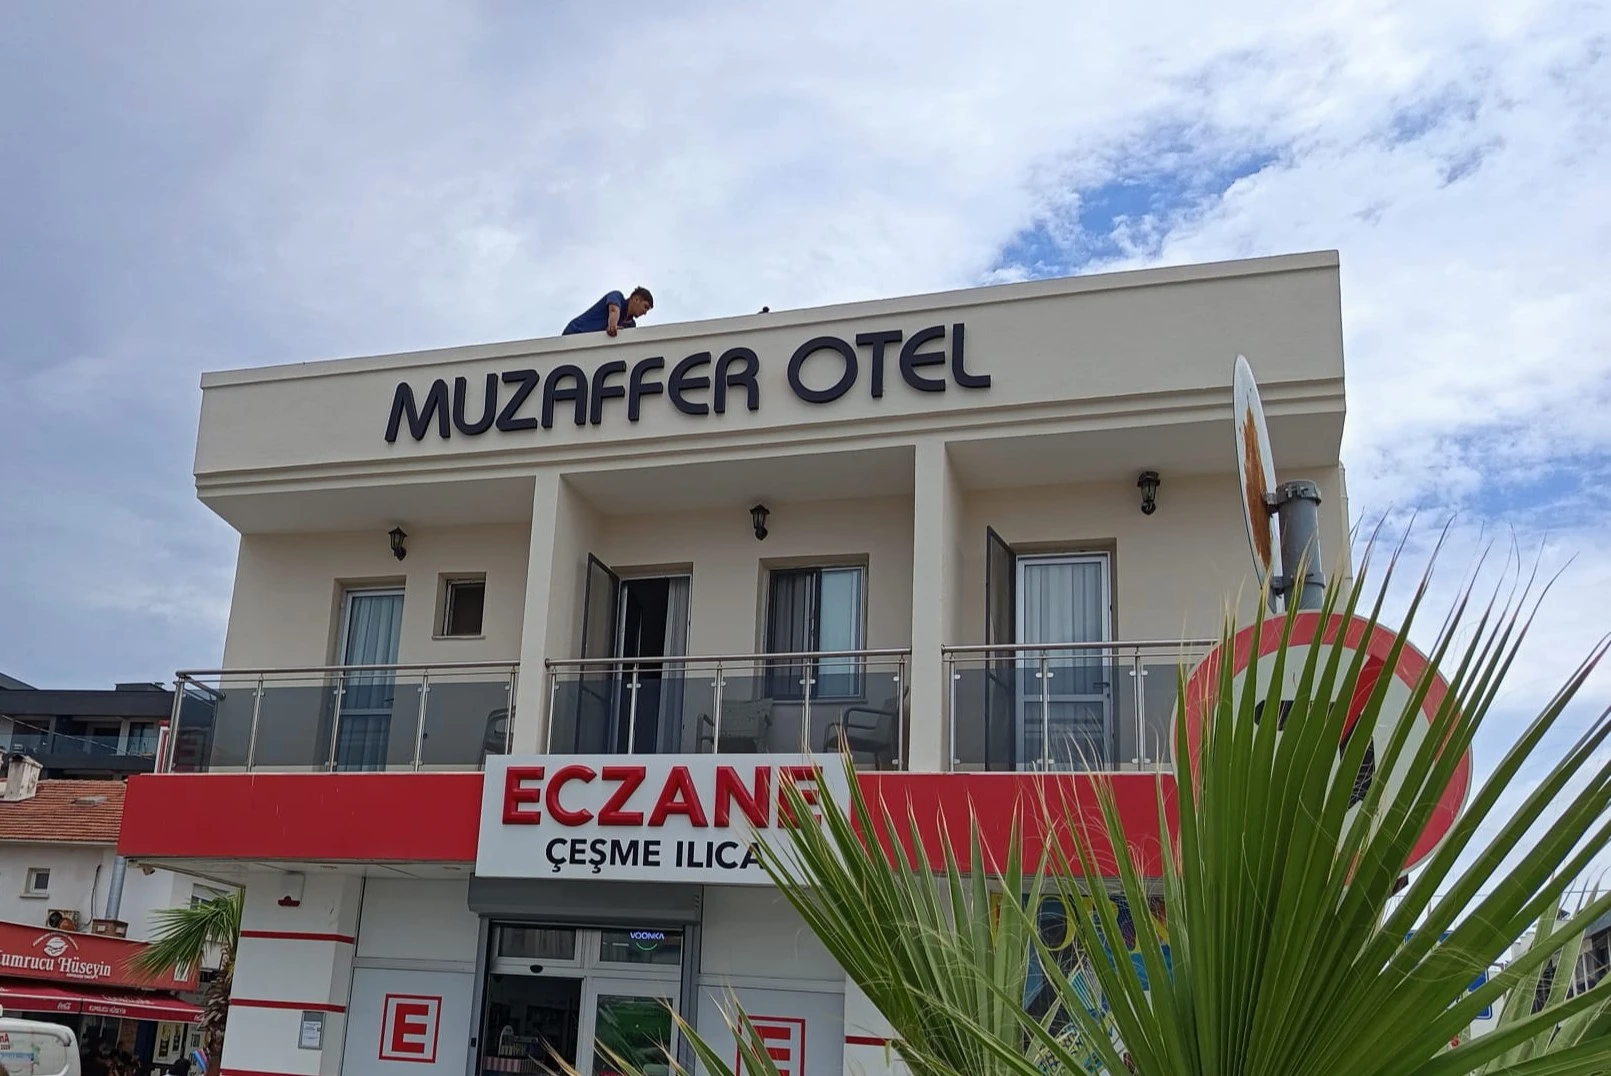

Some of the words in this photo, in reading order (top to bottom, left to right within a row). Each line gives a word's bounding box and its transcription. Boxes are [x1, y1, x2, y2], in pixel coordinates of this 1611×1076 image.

[385, 347, 759, 443] MUZAFFER
[787, 322, 991, 404] OTEL
[502, 765, 824, 830] ECZANE
[545, 838, 662, 874] ÇEŞME
[675, 840, 766, 872] ILICA
[57, 956, 111, 979] Hüseyin
[390, 1003, 430, 1054] E
